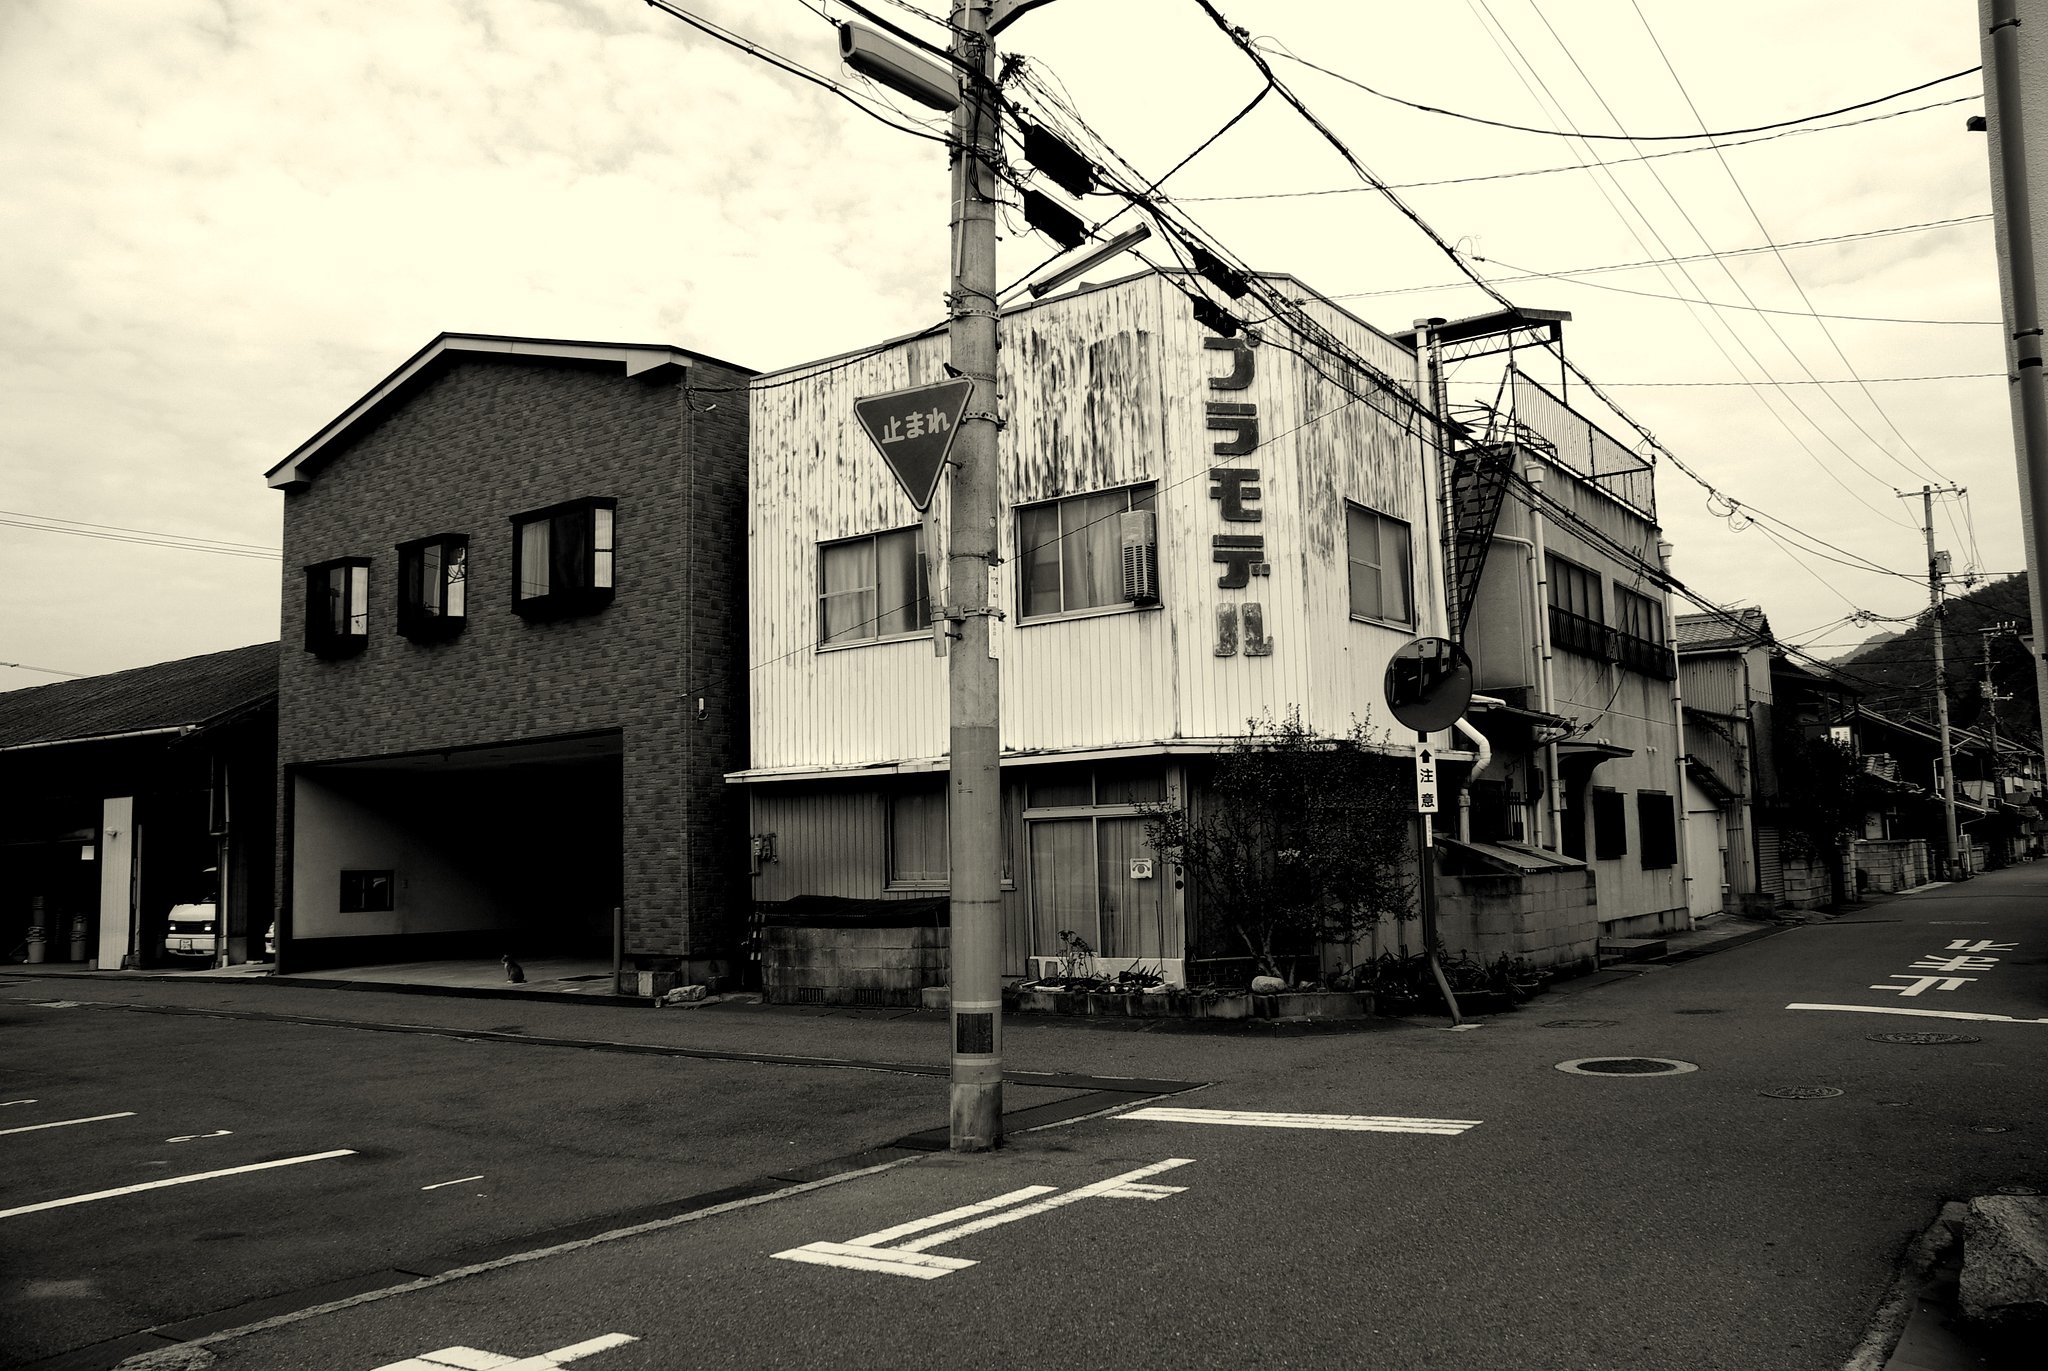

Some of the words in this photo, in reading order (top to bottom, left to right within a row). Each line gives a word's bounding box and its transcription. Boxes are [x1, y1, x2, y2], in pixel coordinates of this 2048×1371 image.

[881, 407, 951, 444] 止まれ
[1203, 330, 1274, 656] プラモデル
[1419, 768, 1436, 808] 注意
